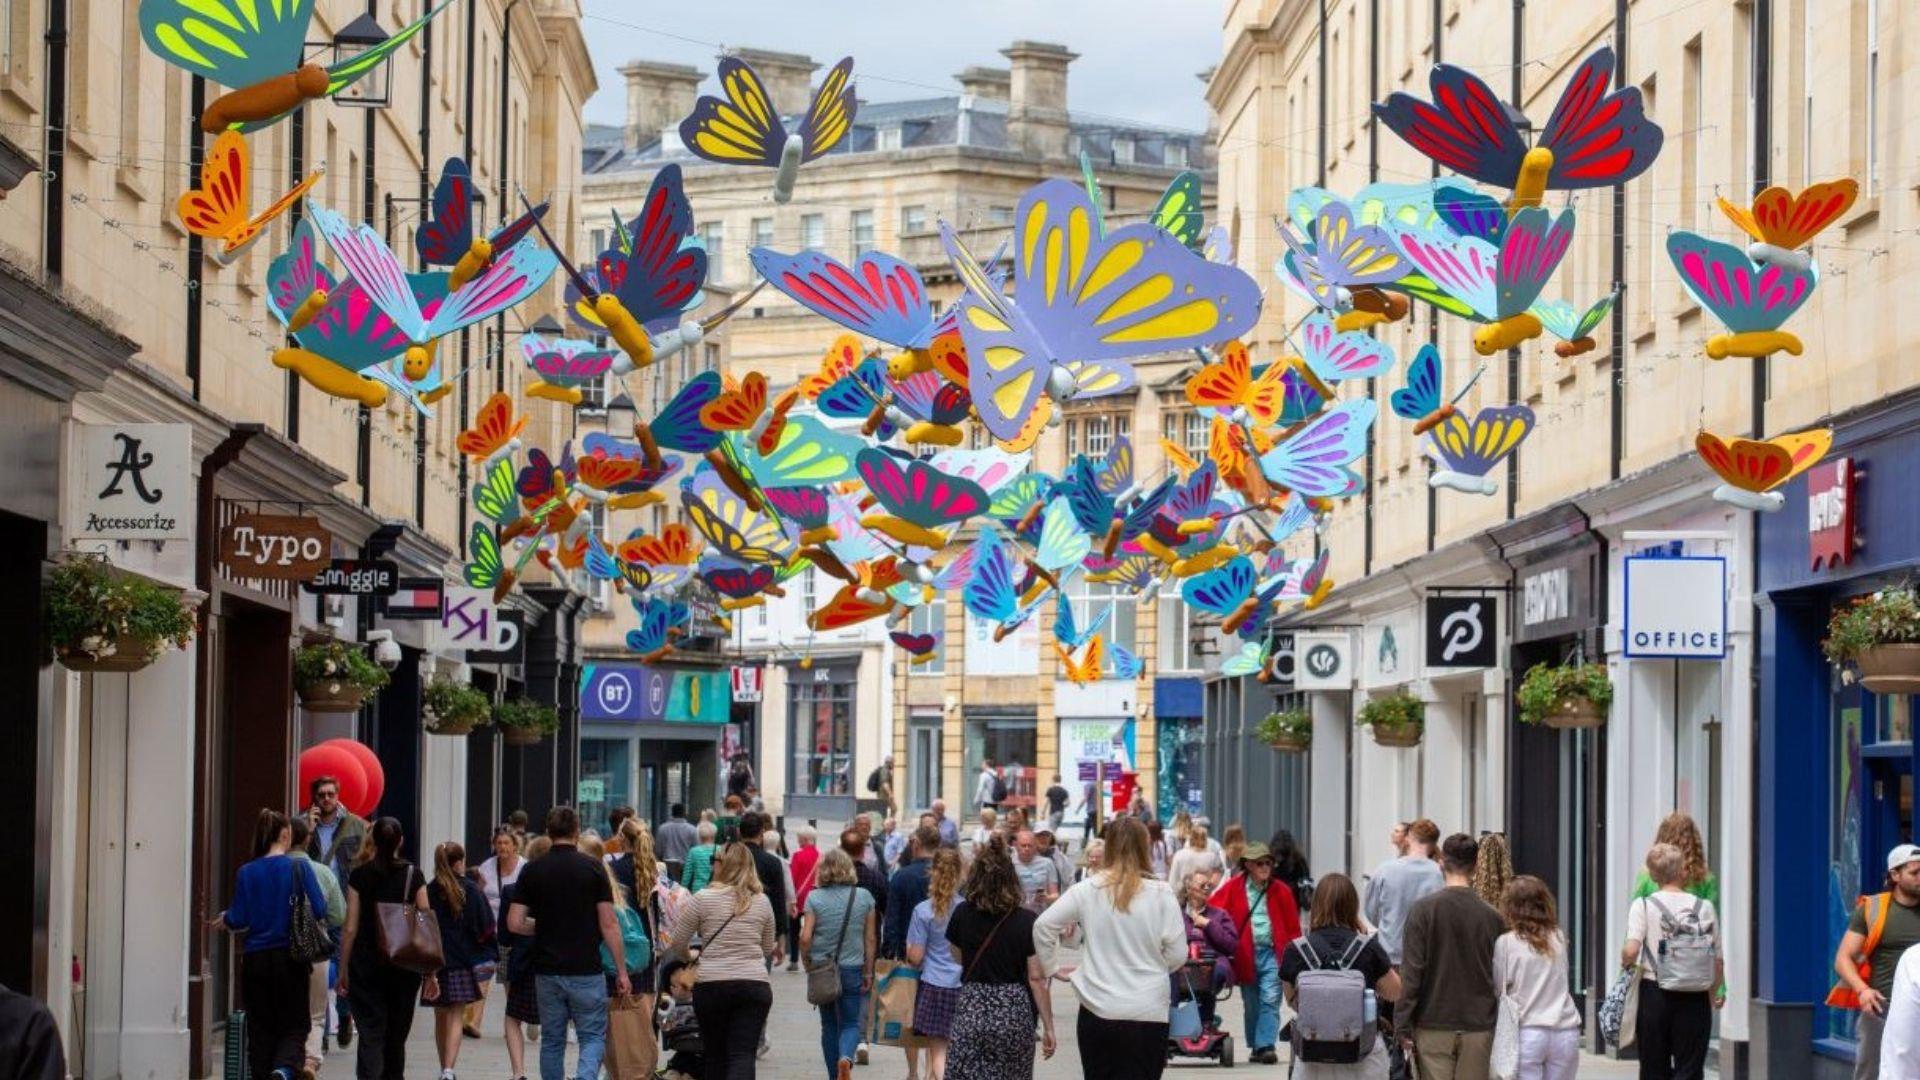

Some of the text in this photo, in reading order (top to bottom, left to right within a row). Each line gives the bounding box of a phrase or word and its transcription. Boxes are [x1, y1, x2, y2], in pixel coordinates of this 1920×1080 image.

[86, 513, 176, 532] Accessorize
[233, 526, 322, 566] Typo
[1635, 631, 1719, 648] OFFICE
[605, 685, 625, 701] BT
